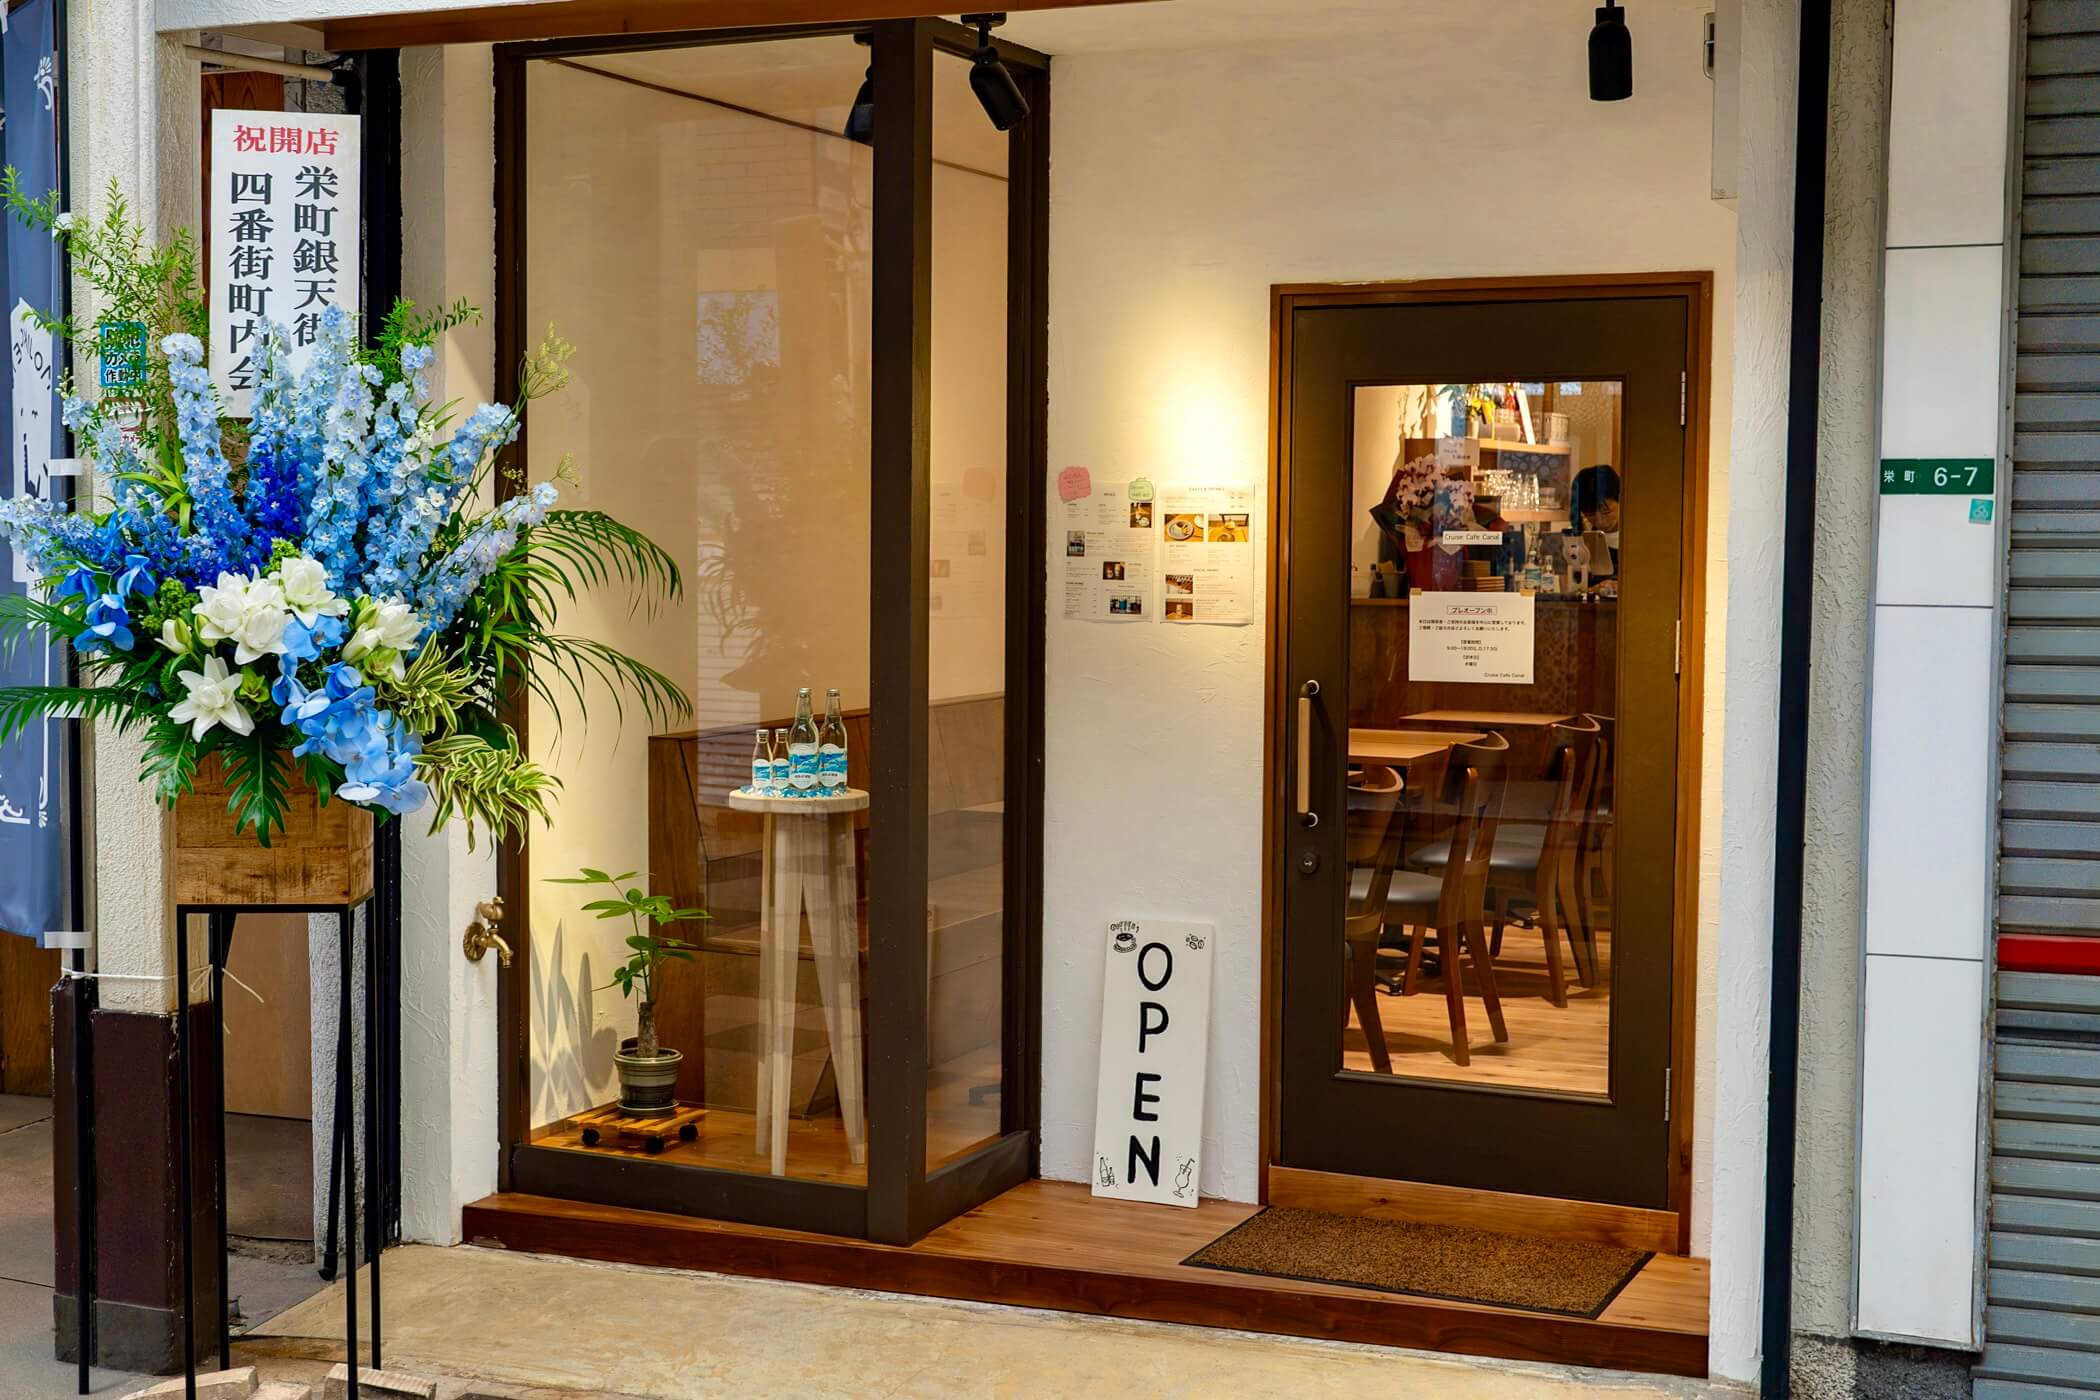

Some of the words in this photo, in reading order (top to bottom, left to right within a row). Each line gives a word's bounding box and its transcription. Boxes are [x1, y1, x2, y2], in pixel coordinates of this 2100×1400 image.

[233, 124, 339, 156] 祝開店
[1883, 470, 1915, 483] 栄町
[1933, 467, 1978, 487] 6-7
[1127, 942, 1173, 1187] OPEN
